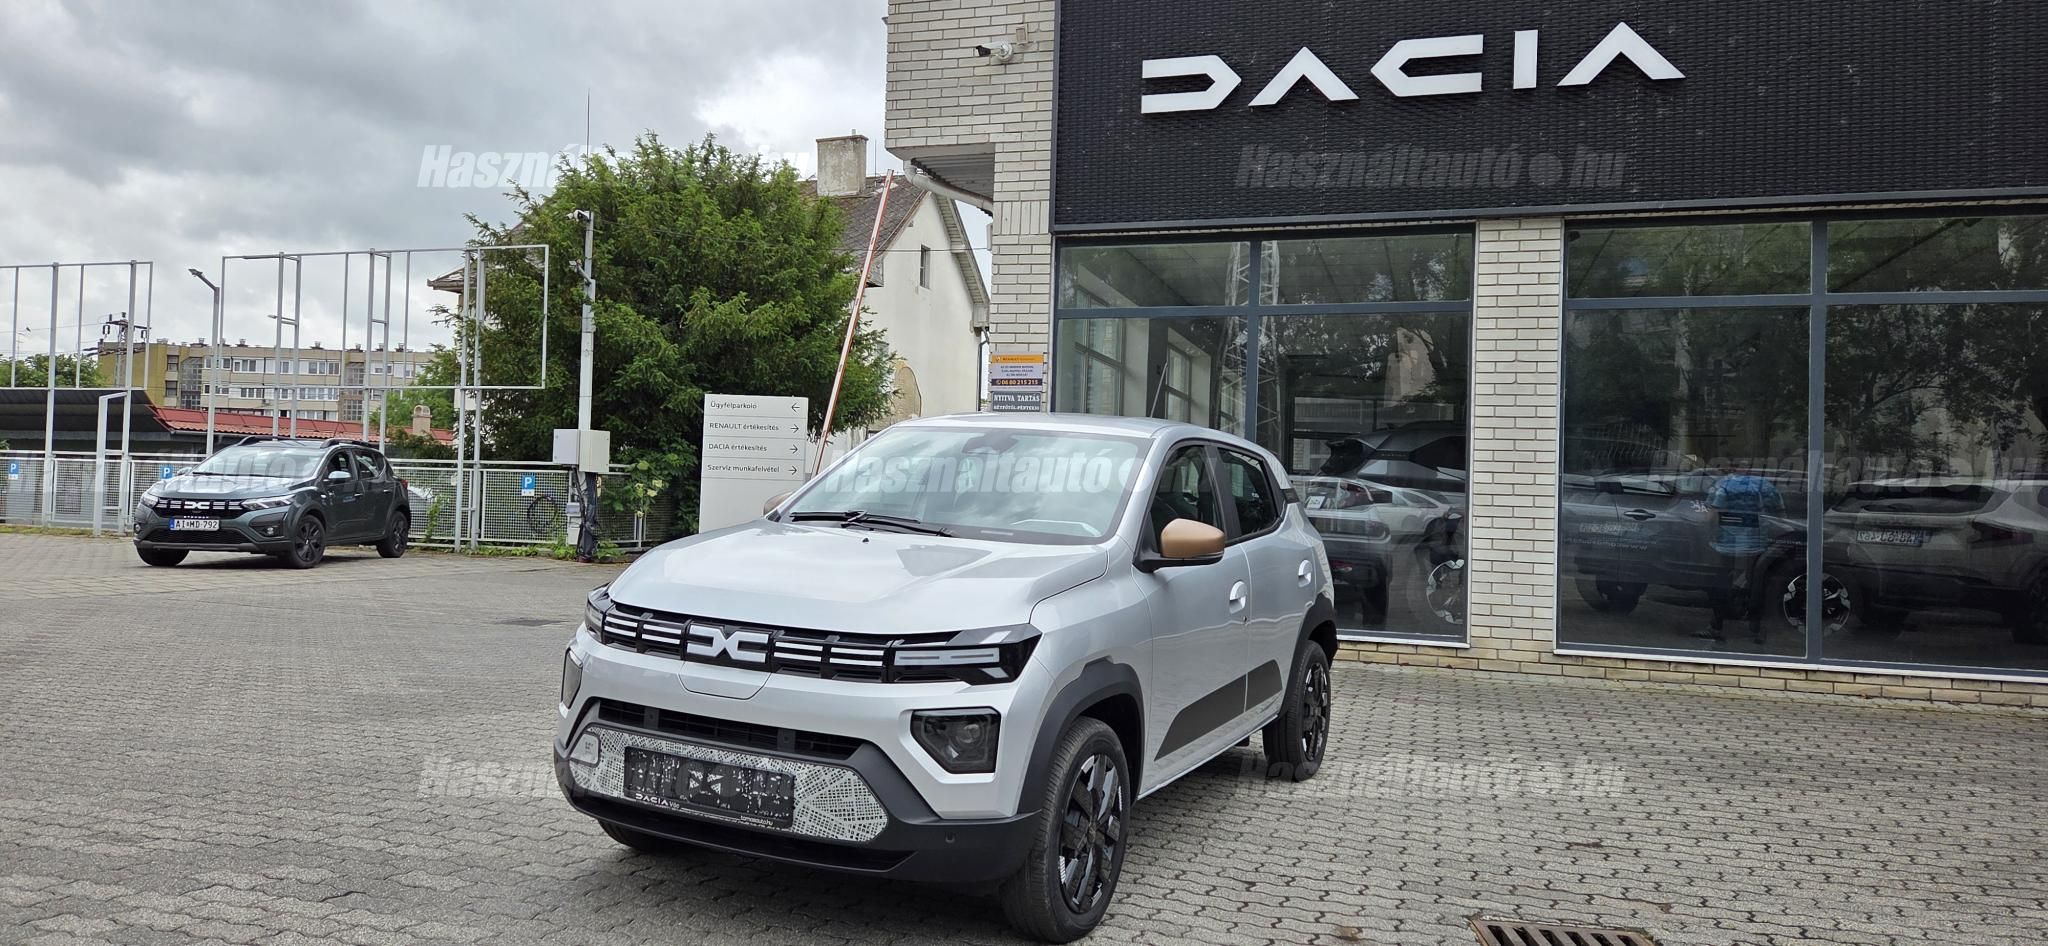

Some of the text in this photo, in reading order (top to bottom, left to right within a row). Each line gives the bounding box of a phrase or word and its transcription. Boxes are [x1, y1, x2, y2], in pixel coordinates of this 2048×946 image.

[1141, 21, 1686, 114] DACIA
[994, 393, 1040, 402] NYITVA TARTÁS
[710, 401, 757, 409] Ügyfélparkoló
[709, 422, 779, 431] RENAULT értékesítés
[731, 444, 768, 452] értékesítés
[732, 465, 780, 473] munkafelvétel
[635, 793, 669, 805] DACIA
